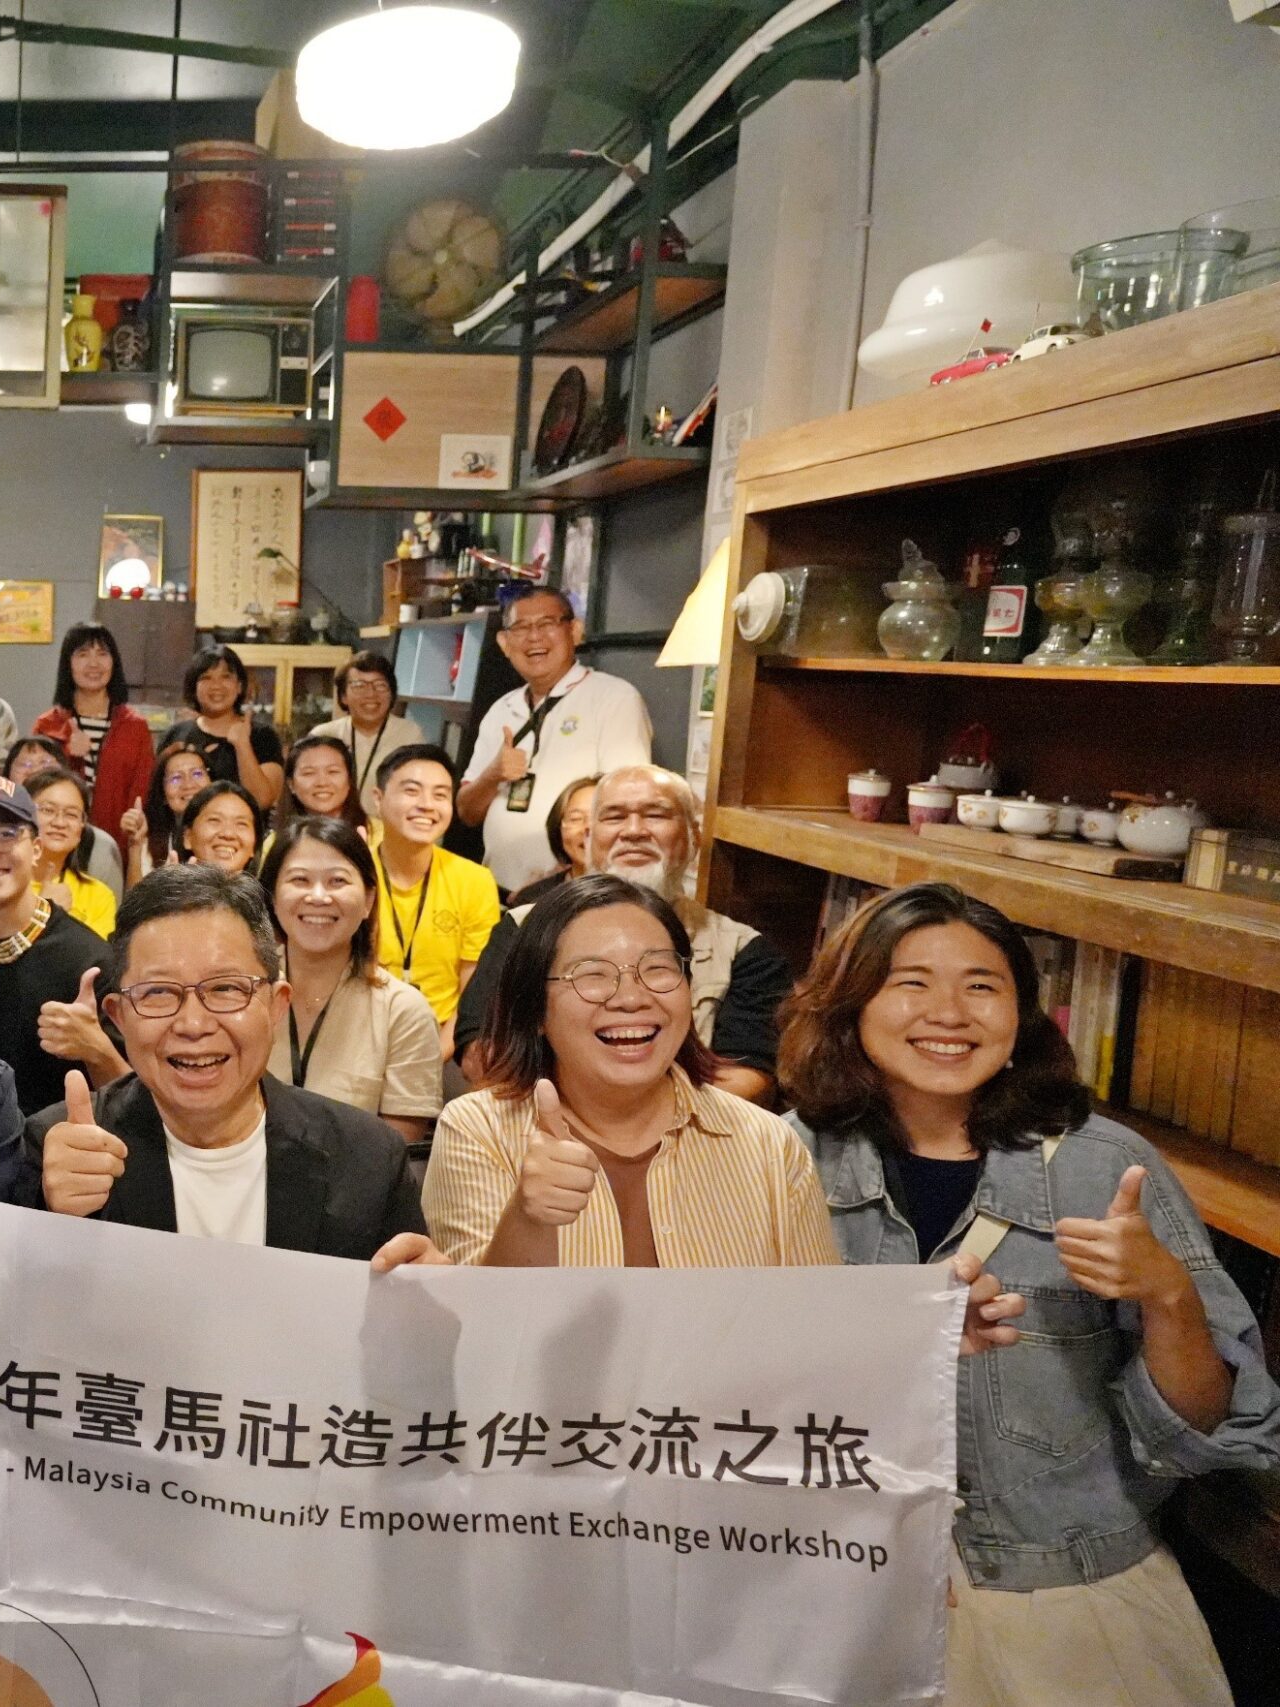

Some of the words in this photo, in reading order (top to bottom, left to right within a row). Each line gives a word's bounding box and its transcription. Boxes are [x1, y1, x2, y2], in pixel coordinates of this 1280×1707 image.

[24, 1455, 151, 1495] Malaysia
[160, 1480, 330, 1528] Community
[340, 1505, 561, 1537] Empowerment
[569, 1511, 710, 1555] Exchange
[718, 1525, 889, 1573] Workshop
